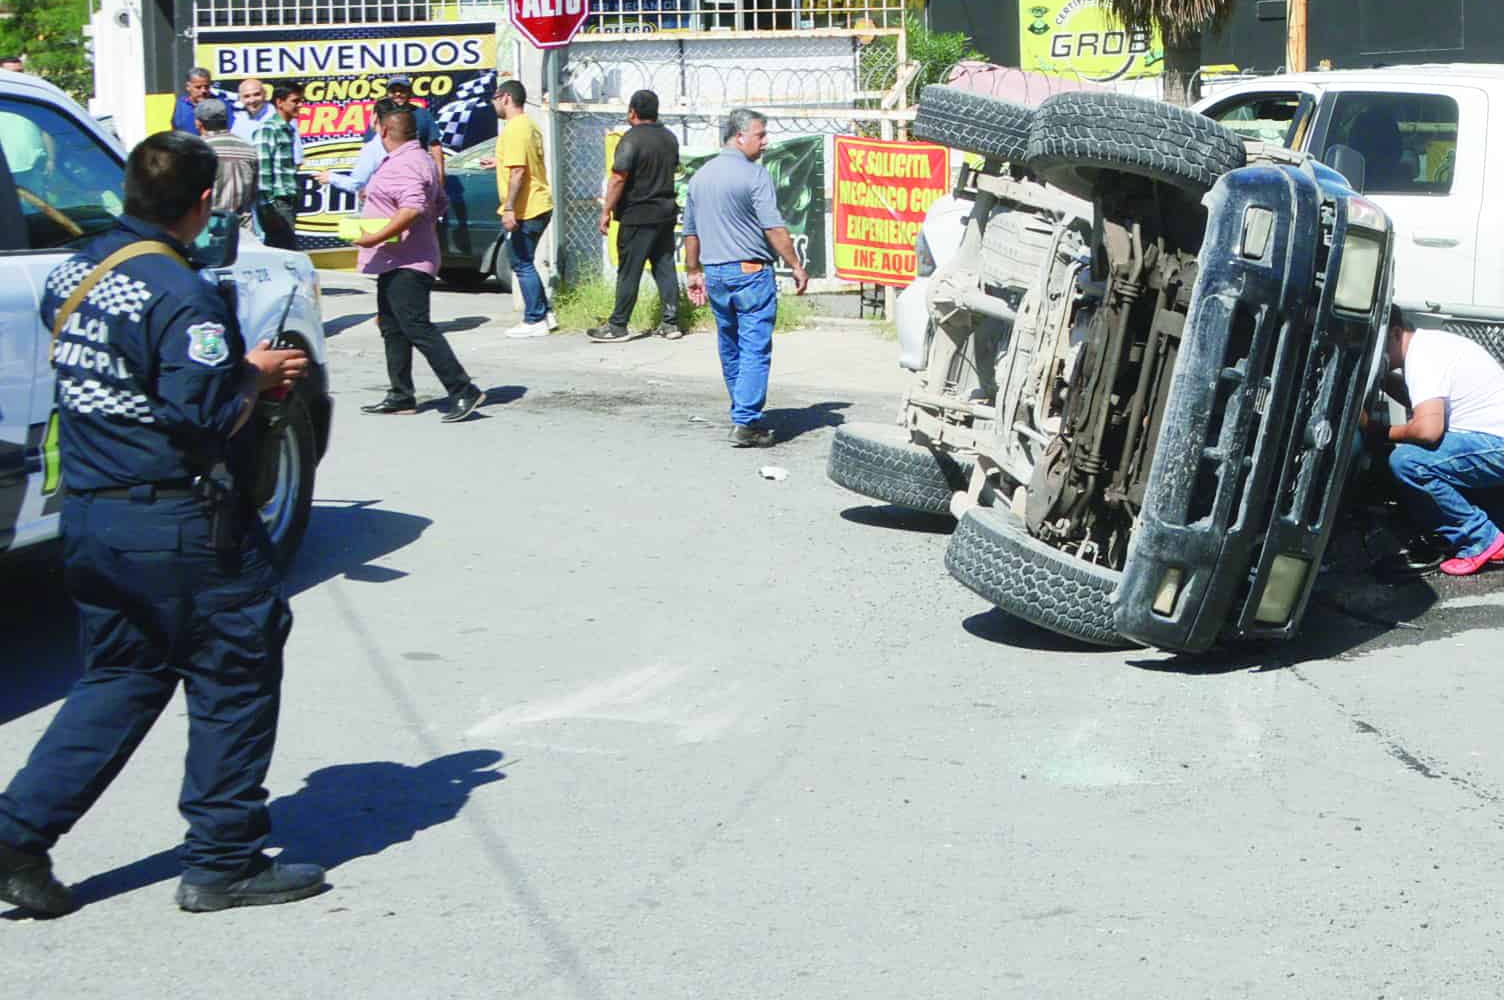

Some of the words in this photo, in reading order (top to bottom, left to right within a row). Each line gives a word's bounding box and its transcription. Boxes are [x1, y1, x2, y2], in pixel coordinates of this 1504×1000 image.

[219, 40, 481, 74] BIENVENIDOS
[1051, 31, 1148, 58] GROB
[848, 148, 866, 173] SE
[865, 151, 932, 179] SOLICITA
[847, 214, 923, 246] EXPERIENC
[882, 253, 917, 273] AQU
